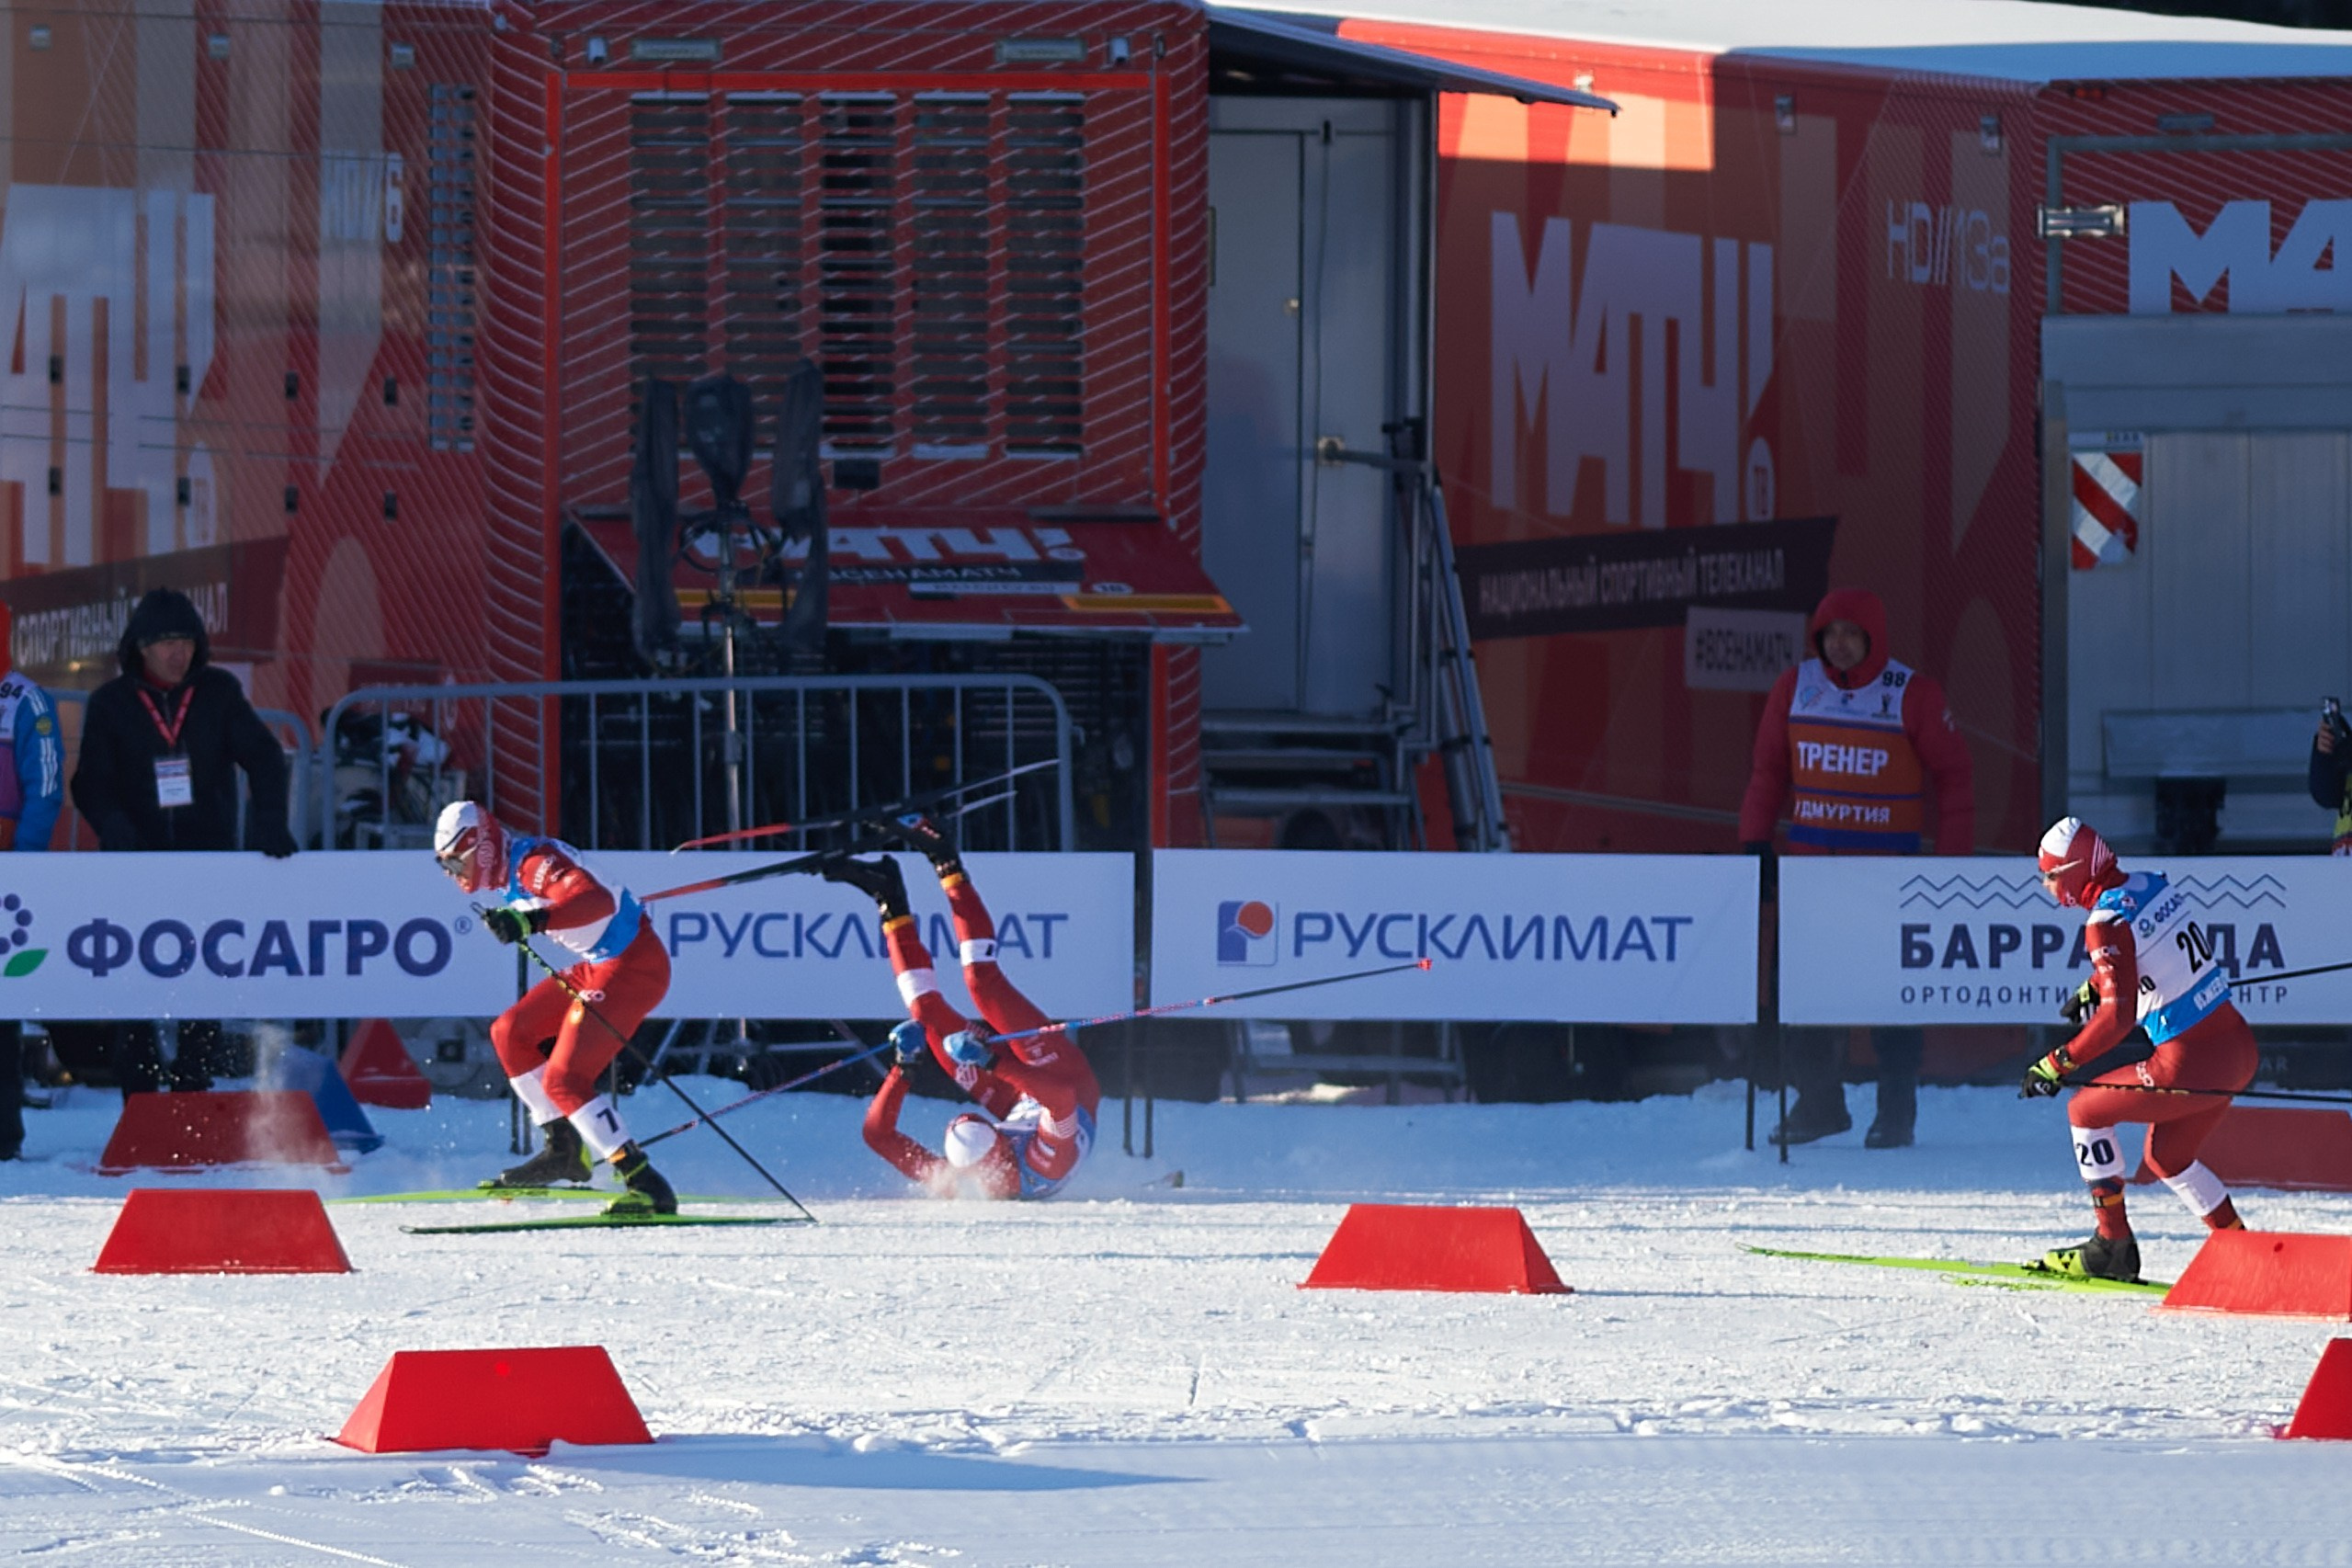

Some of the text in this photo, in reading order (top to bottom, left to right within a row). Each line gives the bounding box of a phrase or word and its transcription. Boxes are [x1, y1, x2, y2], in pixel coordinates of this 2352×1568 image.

[1600, 546, 1698, 605] СПОРТИВНЫЙ
[1699, 548, 1785, 596] ТЕЛЕКАНАЛ
[1881, 670, 1906, 687] 98
[1797, 741, 1890, 776] ТРЕНЕР
[670, 912, 1069, 959] РУСКЛМАТ
[1292, 911, 1694, 962] РУСКЛИМАТ
[1900, 923, 2286, 979] БАРРАДА
[2176, 921, 2213, 974] 20
[1901, 985, 2069, 1007] ОРТОДОНТИ
[595, 1107, 621, 1134] 7
[2076, 1138, 2115, 1166] 20
